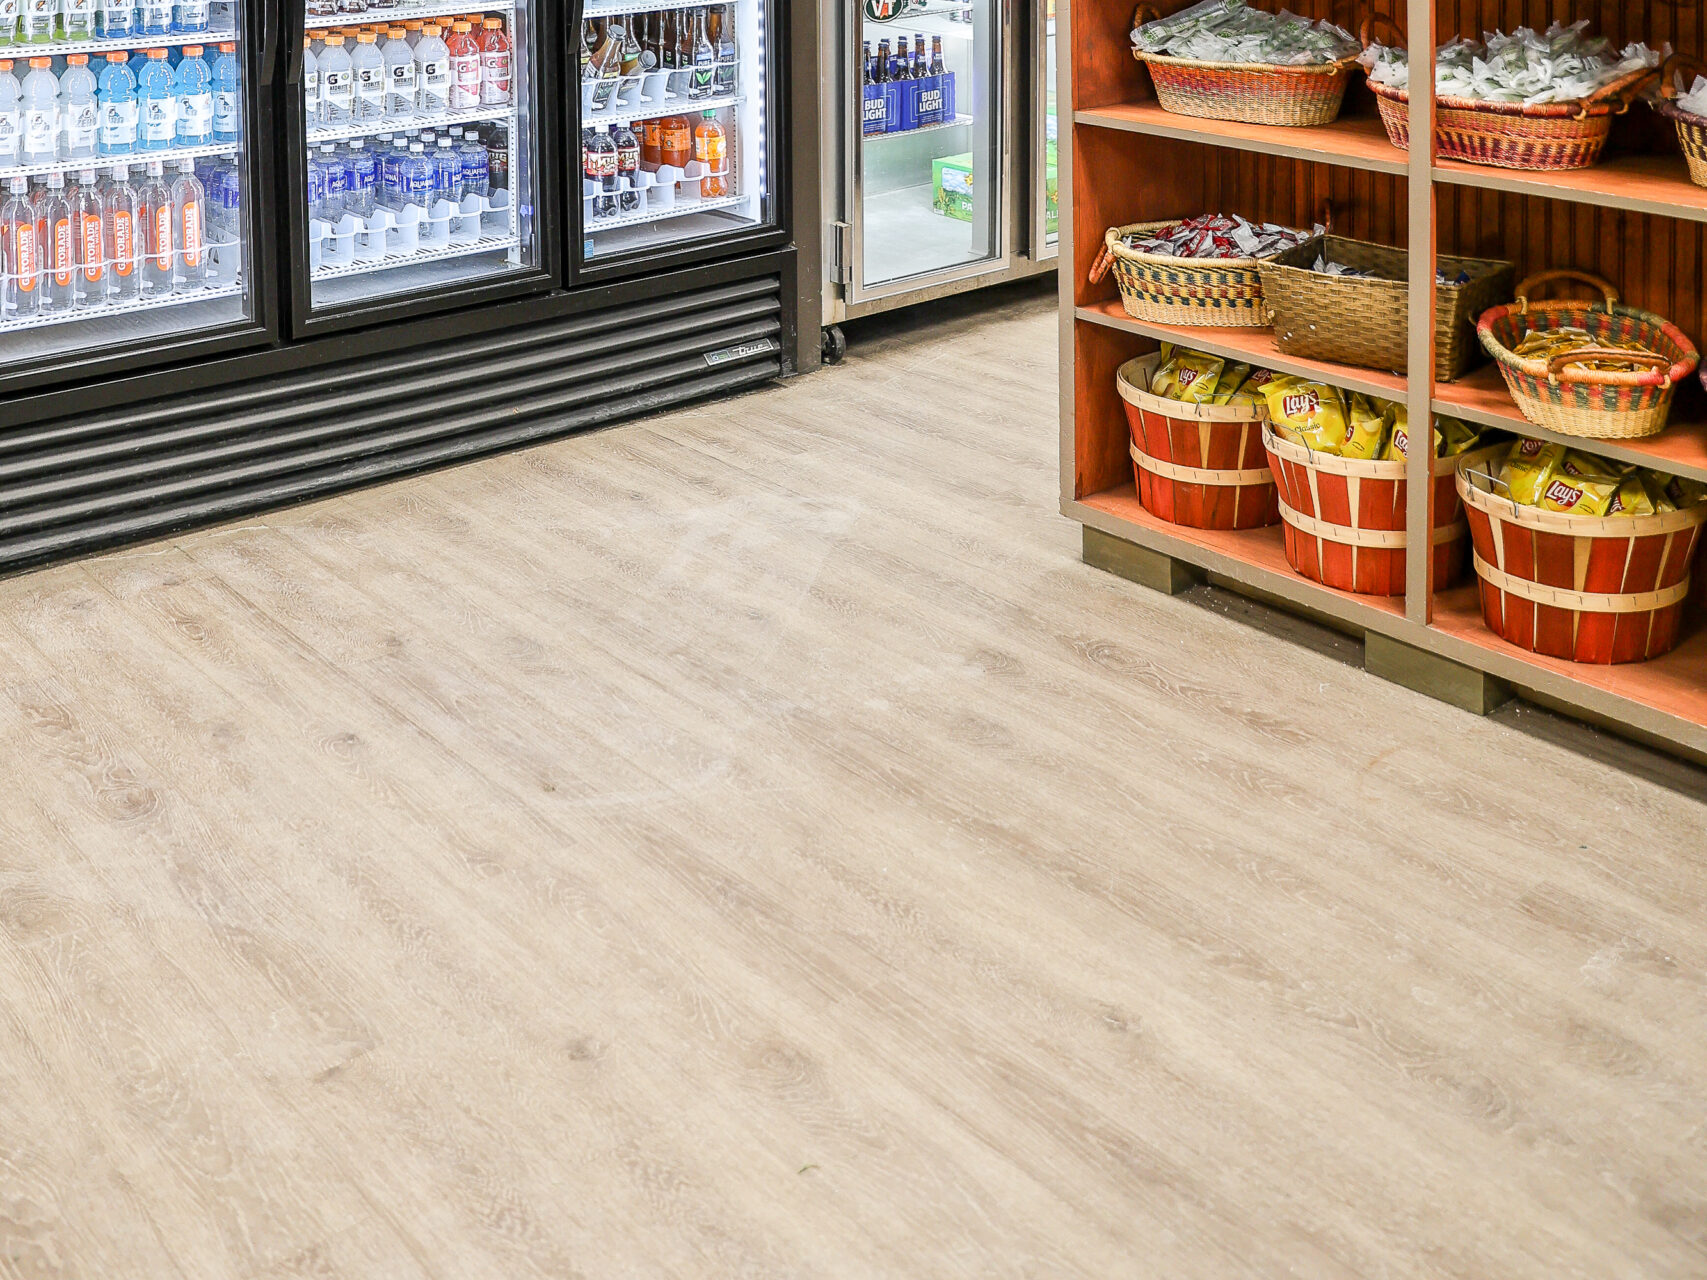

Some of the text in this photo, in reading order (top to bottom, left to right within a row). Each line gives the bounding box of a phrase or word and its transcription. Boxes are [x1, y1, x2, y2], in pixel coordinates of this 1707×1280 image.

[393, 66, 405, 77] G
[425, 63, 436, 75] G
[328, 73, 338, 85] G
[921, 90, 941, 102] BUD
[865, 99, 884, 111] BUD
[919, 99, 943, 113] LIGHT
[1285, 391, 1317, 415] Lay's
[1545, 480, 1582, 506] Lay's
